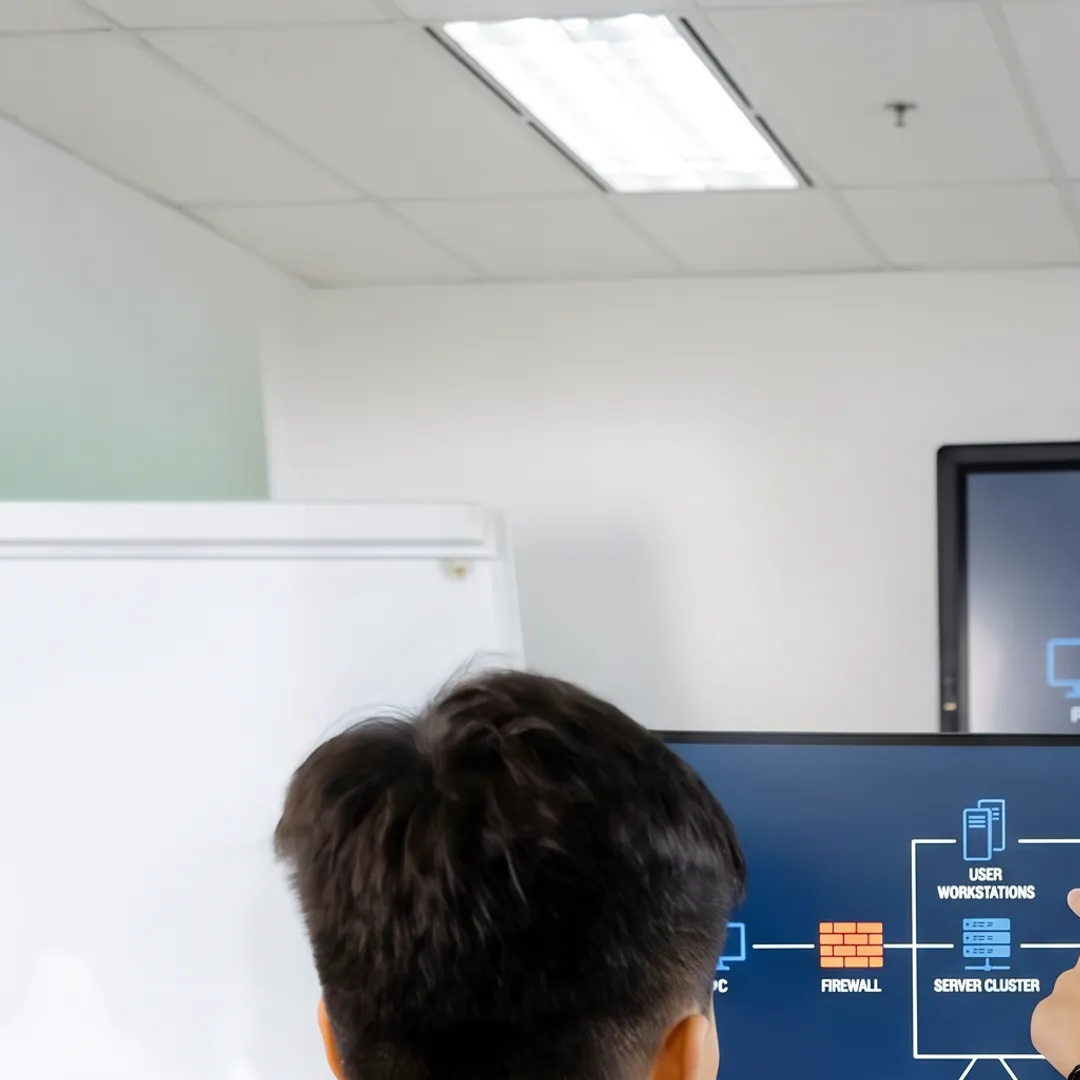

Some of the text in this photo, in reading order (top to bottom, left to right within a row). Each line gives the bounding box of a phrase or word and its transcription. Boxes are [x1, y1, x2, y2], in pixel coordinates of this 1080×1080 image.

[968, 867, 1003, 882] USER
[937, 885, 1036, 900] WORKSTATIONS
[821, 978, 882, 993] FIREWALL
[933, 978, 1040, 993] SERVER CLUSTER
